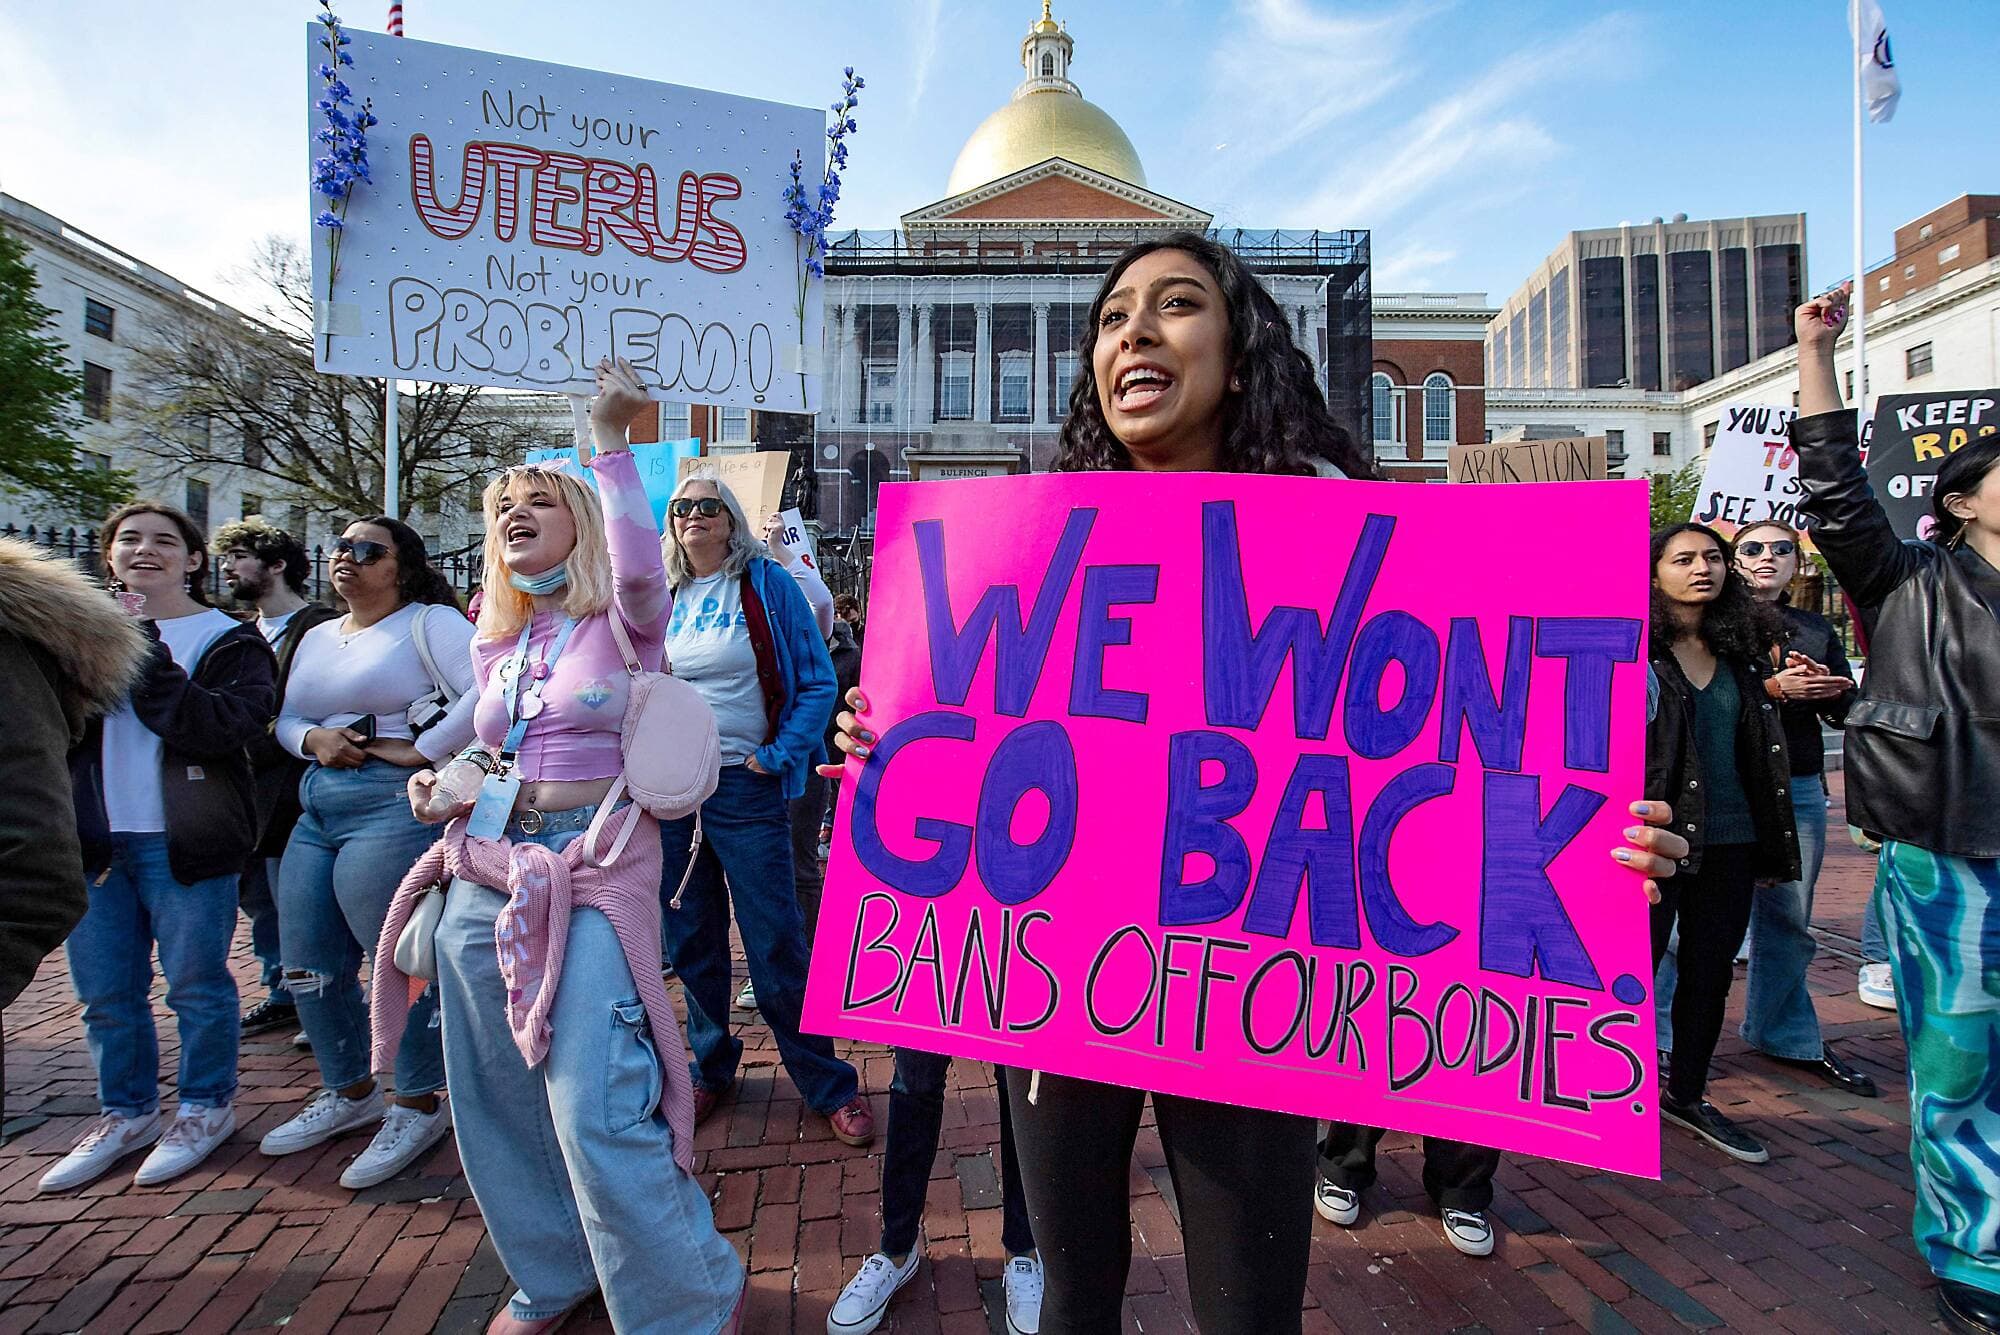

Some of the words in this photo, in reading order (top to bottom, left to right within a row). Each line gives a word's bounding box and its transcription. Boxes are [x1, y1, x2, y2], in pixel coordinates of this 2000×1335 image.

[481, 88, 556, 133] Not
[570, 110, 660, 149] your
[409, 132, 747, 274] UTERUS
[486, 253, 552, 294] Not
[569, 267, 652, 304] your
[389, 276, 773, 404] PROBLEM!
[1727, 407, 1770, 435] YOU
[1896, 399, 1995, 432] KEEP
[940, 469, 988, 477] BULFINCH
[1459, 441, 1593, 484] ABORTION
[1700, 491, 1756, 526] SEE
[912, 506, 1160, 724] WE
[1201, 500, 1643, 773] WONT
[850, 710, 1079, 905] GO
[1158, 730, 1647, 1006] BACK.
[841, 891, 1060, 1032] BANS
[1084, 924, 1251, 1053] OFF
[1240, 949, 1376, 1072] OUR
[1386, 963, 1646, 1115] BODIES.
